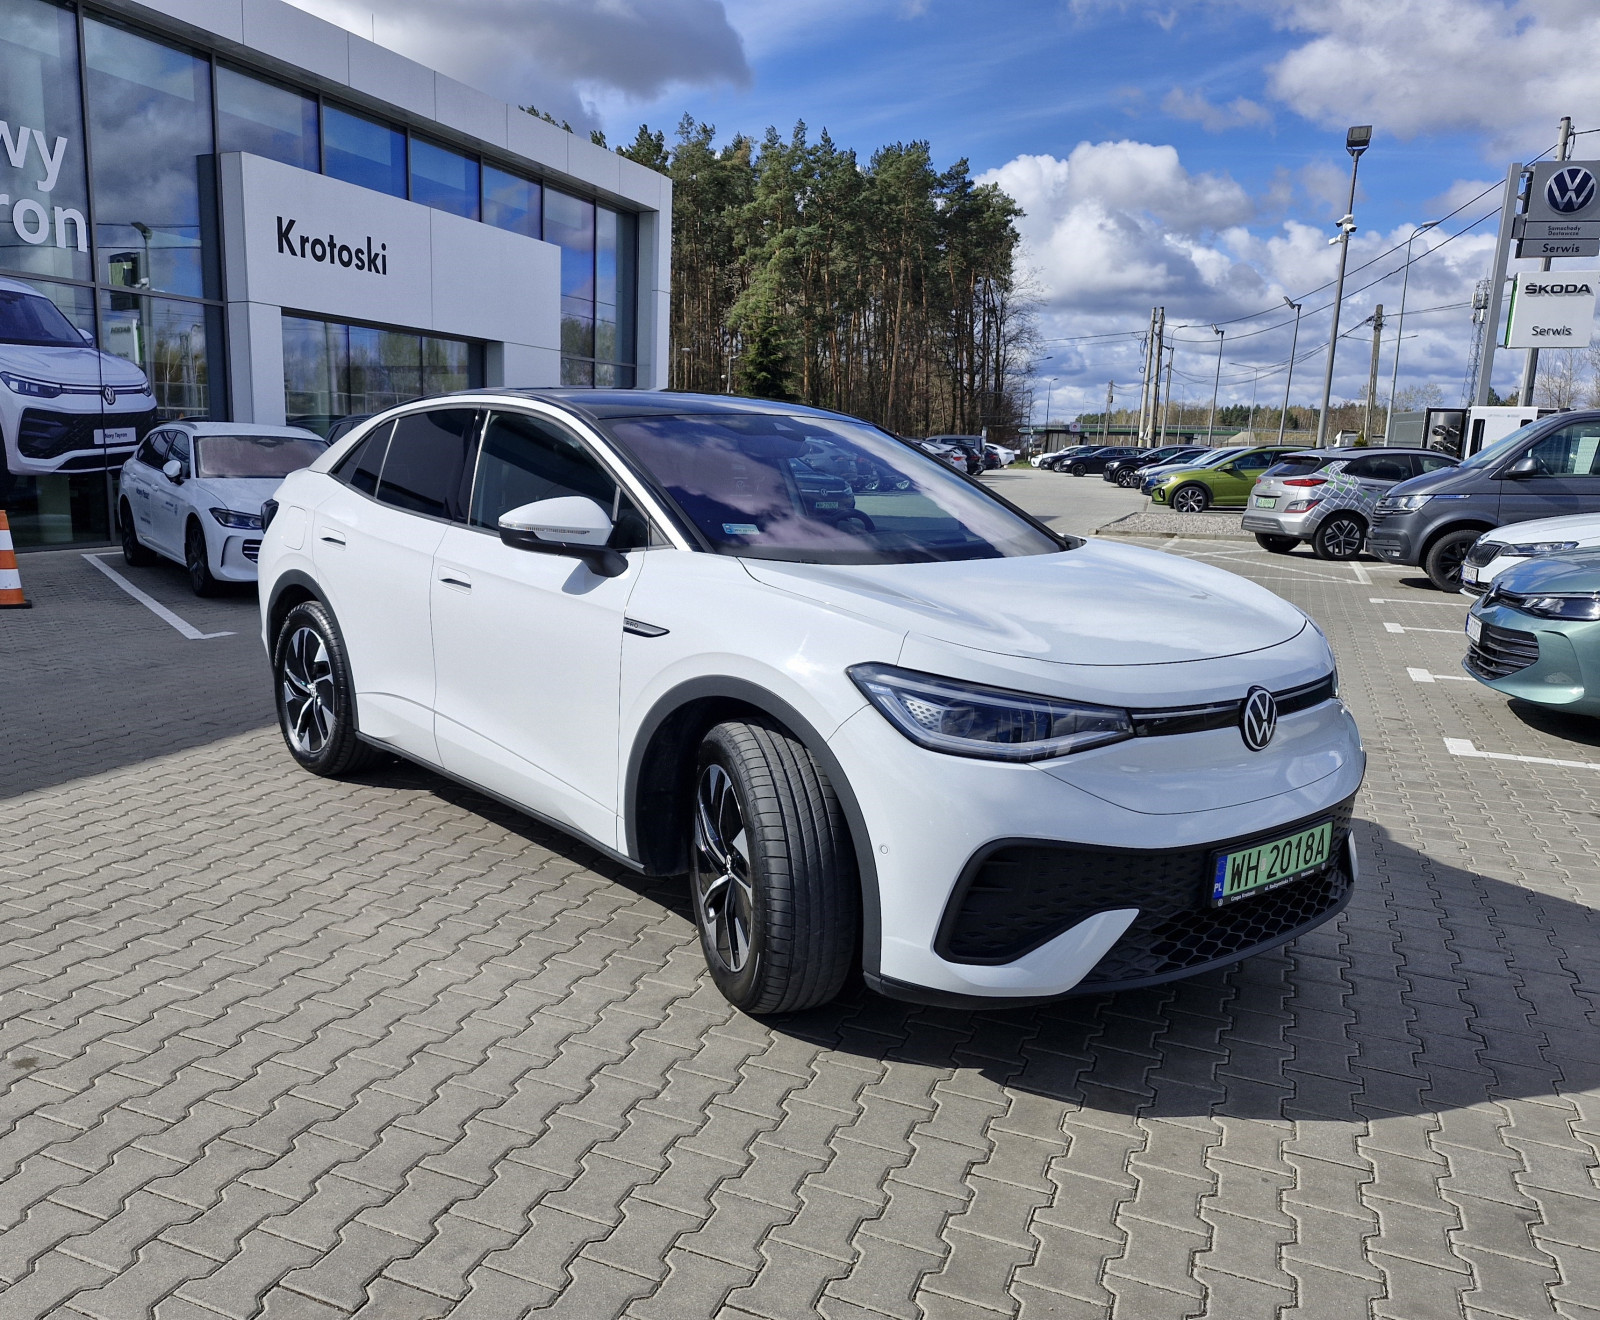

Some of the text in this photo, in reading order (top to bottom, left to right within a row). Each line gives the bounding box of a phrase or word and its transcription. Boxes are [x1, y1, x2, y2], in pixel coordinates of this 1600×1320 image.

[276, 215, 387, 275] Krotoski
[1542, 243, 1580, 253] Serwis
[1525, 282, 1592, 295] ŠKODA
[1531, 325, 1572, 336] Serwis
[625, 620, 639, 628] PRO
[1230, 828, 1325, 891] WH 2018A
[1213, 882, 1222, 893] PL
